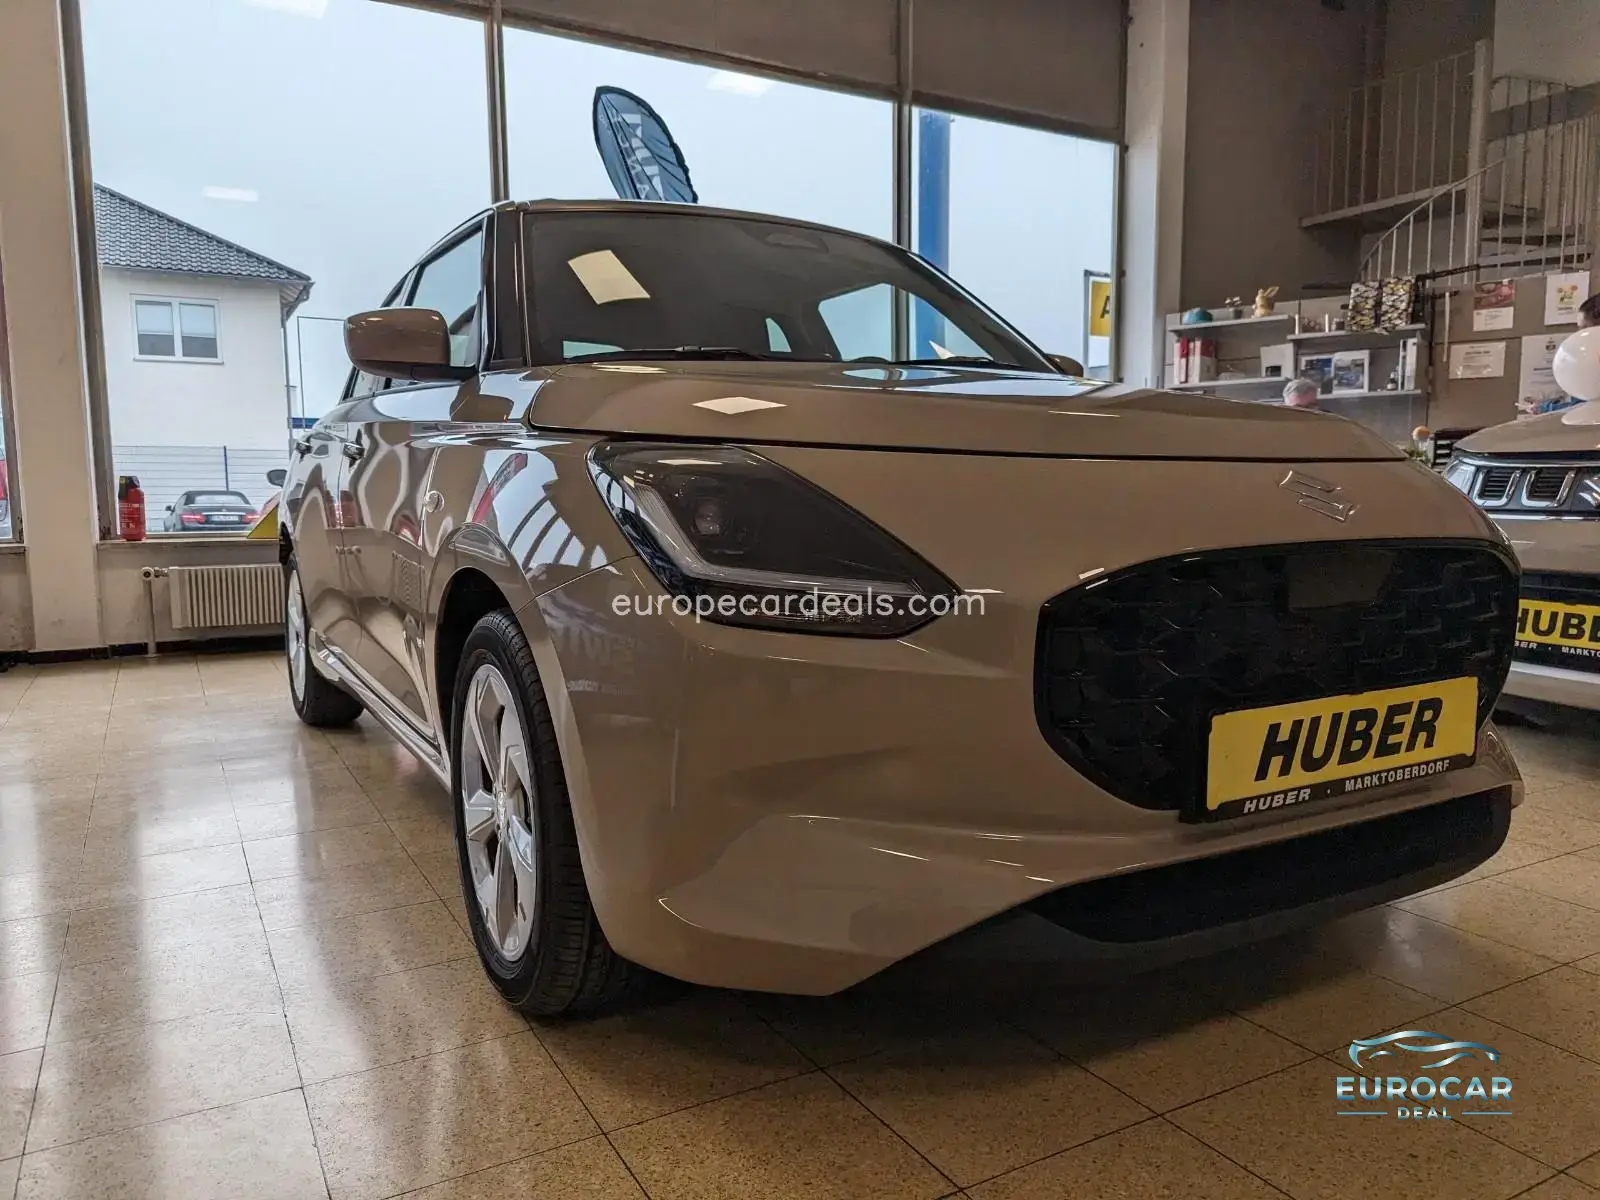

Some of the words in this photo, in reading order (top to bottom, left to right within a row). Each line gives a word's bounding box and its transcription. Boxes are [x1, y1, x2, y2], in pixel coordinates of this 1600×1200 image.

[1254, 697, 1443, 782] HUBER
[1243, 788, 1311, 814] HUBER
[1344, 759, 1451, 792] MARKTOBERDORF
